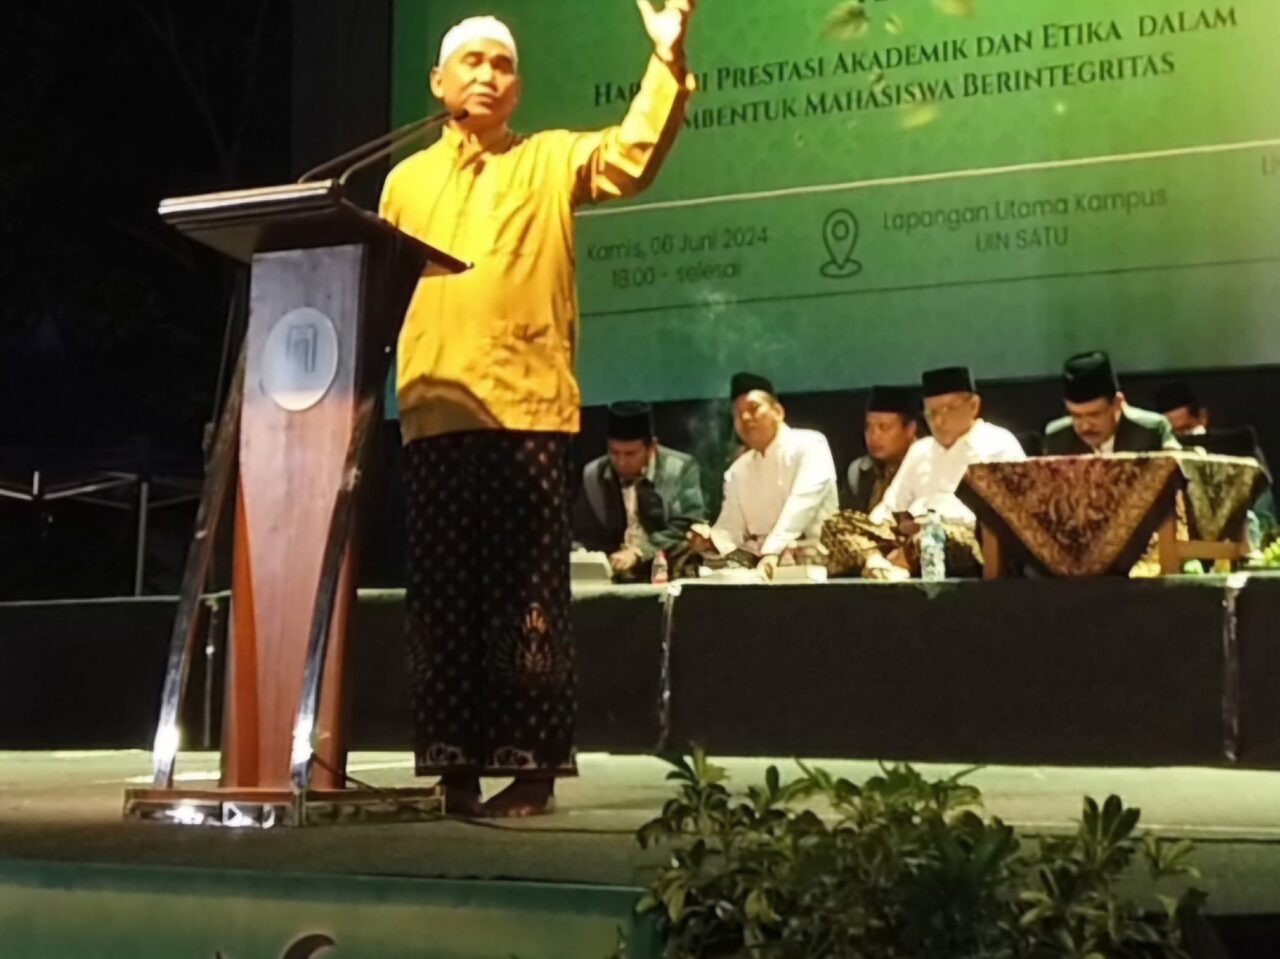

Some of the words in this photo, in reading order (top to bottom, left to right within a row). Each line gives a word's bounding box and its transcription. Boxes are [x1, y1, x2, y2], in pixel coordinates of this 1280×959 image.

[882, 203, 989, 235] Lapangan
[995, 196, 1069, 221] Utama
[1073, 187, 1167, 216] Kampus
[722, 226, 768, 249] 2024
[976, 229, 1010, 253] UIN
[1015, 226, 1069, 249] SATU
